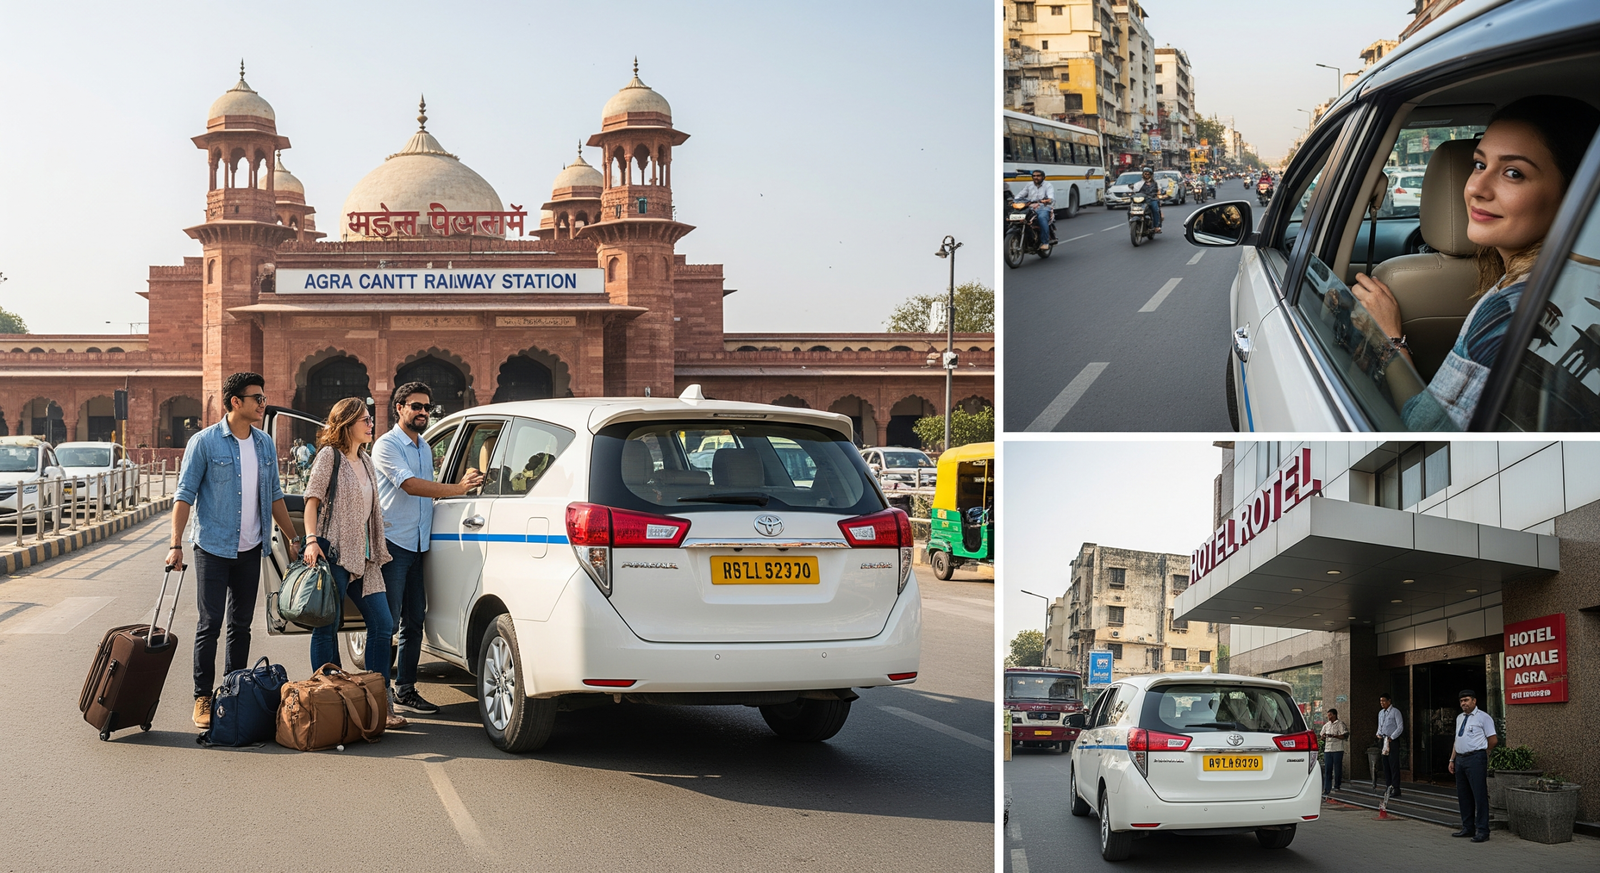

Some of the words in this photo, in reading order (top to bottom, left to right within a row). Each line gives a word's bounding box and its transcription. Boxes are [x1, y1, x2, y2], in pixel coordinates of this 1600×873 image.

[304, 273, 353, 289] AGRA
[359, 273, 418, 289] CANTT
[424, 273, 496, 289] RAILWAY
[502, 273, 577, 289] STATION
[1235, 448, 1322, 546] ROTEL
[1509, 626, 1556, 647] HOTEL
[1506, 649, 1559, 669] ROYALE
[1514, 670, 1548, 685] AGRA
